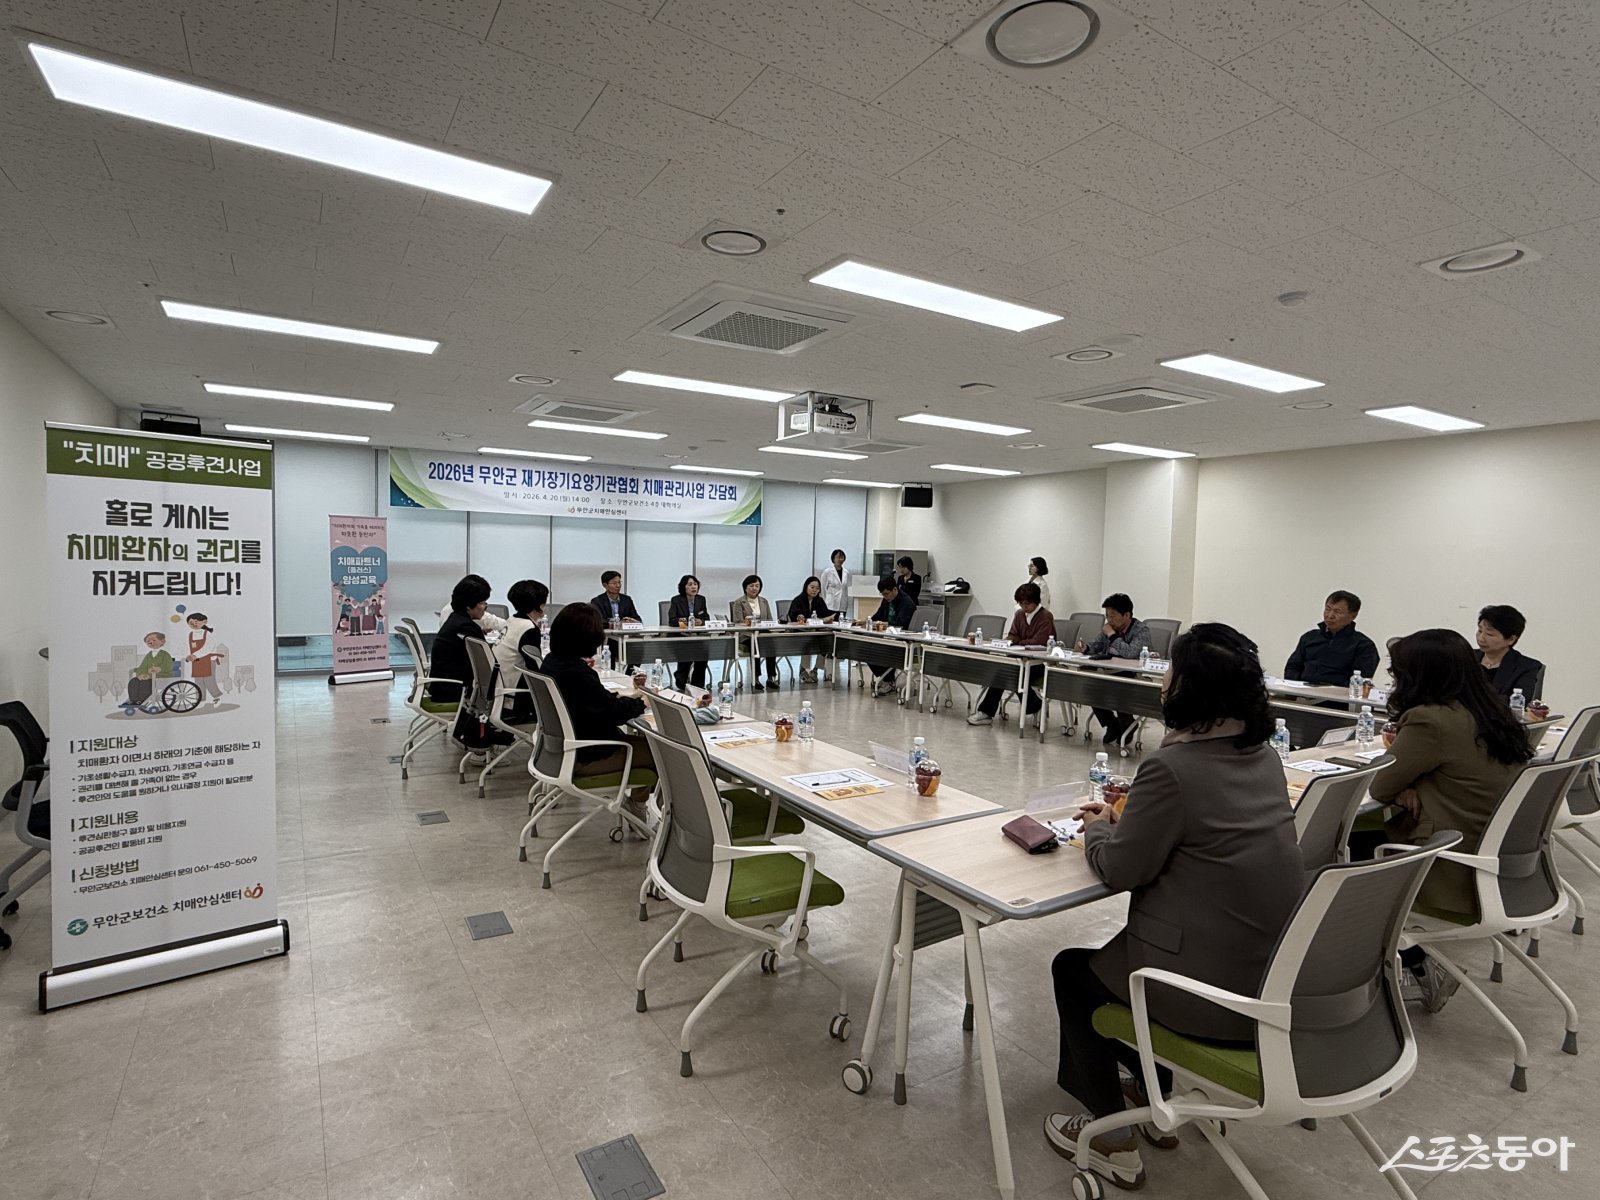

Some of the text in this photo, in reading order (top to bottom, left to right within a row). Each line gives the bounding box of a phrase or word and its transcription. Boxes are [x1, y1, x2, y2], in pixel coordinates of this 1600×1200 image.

[63, 440, 260, 477] "치매" 공공후견사업
[428, 462, 737, 501] 2026년 무안군 재가장기요양기관협회 치매관리사업 간담회
[105, 499, 229, 531] 홀로 계시는
[576, 506, 627, 515] 무안군치매안심센터
[67, 534, 261, 564] 치매환자의 권리를
[337, 556, 380, 566] 치매파트너
[92, 570, 242, 596] 지켜드립니다!
[343, 575, 377, 585] 양성교육
[77, 735, 138, 752] 지원대상
[77, 756, 120, 768] 치매환자
[122, 753, 152, 764] 이면서
[184, 746, 212, 757] 기준에
[214, 743, 250, 753] 해당하는
[252, 741, 261, 750] 자
[172, 762, 202, 772] 기초연금
[203, 759, 226, 768] 수급자
[78, 783, 103, 793] 권리를
[105, 781, 129, 790] 대변해
[140, 776, 163, 786] 가족이
[182, 772, 197, 780] 경우
[78, 793, 112, 804] 후견인의
[171, 781, 201, 792] 의사결정
[202, 778, 224, 787] 지원이
[78, 810, 139, 831] 지원내용
[129, 826, 145, 836] 절차
[156, 819, 187, 831] 비용지원
[78, 842, 120, 855] 공공후견인
[147, 835, 163, 844] 지원
[79, 859, 139, 881] 신청방법
[79, 856, 258, 895] 무안군보건소 치매안심센터 문의 061-450-5069
[92, 889, 242, 929] 무안군보건소 치매안심센터
